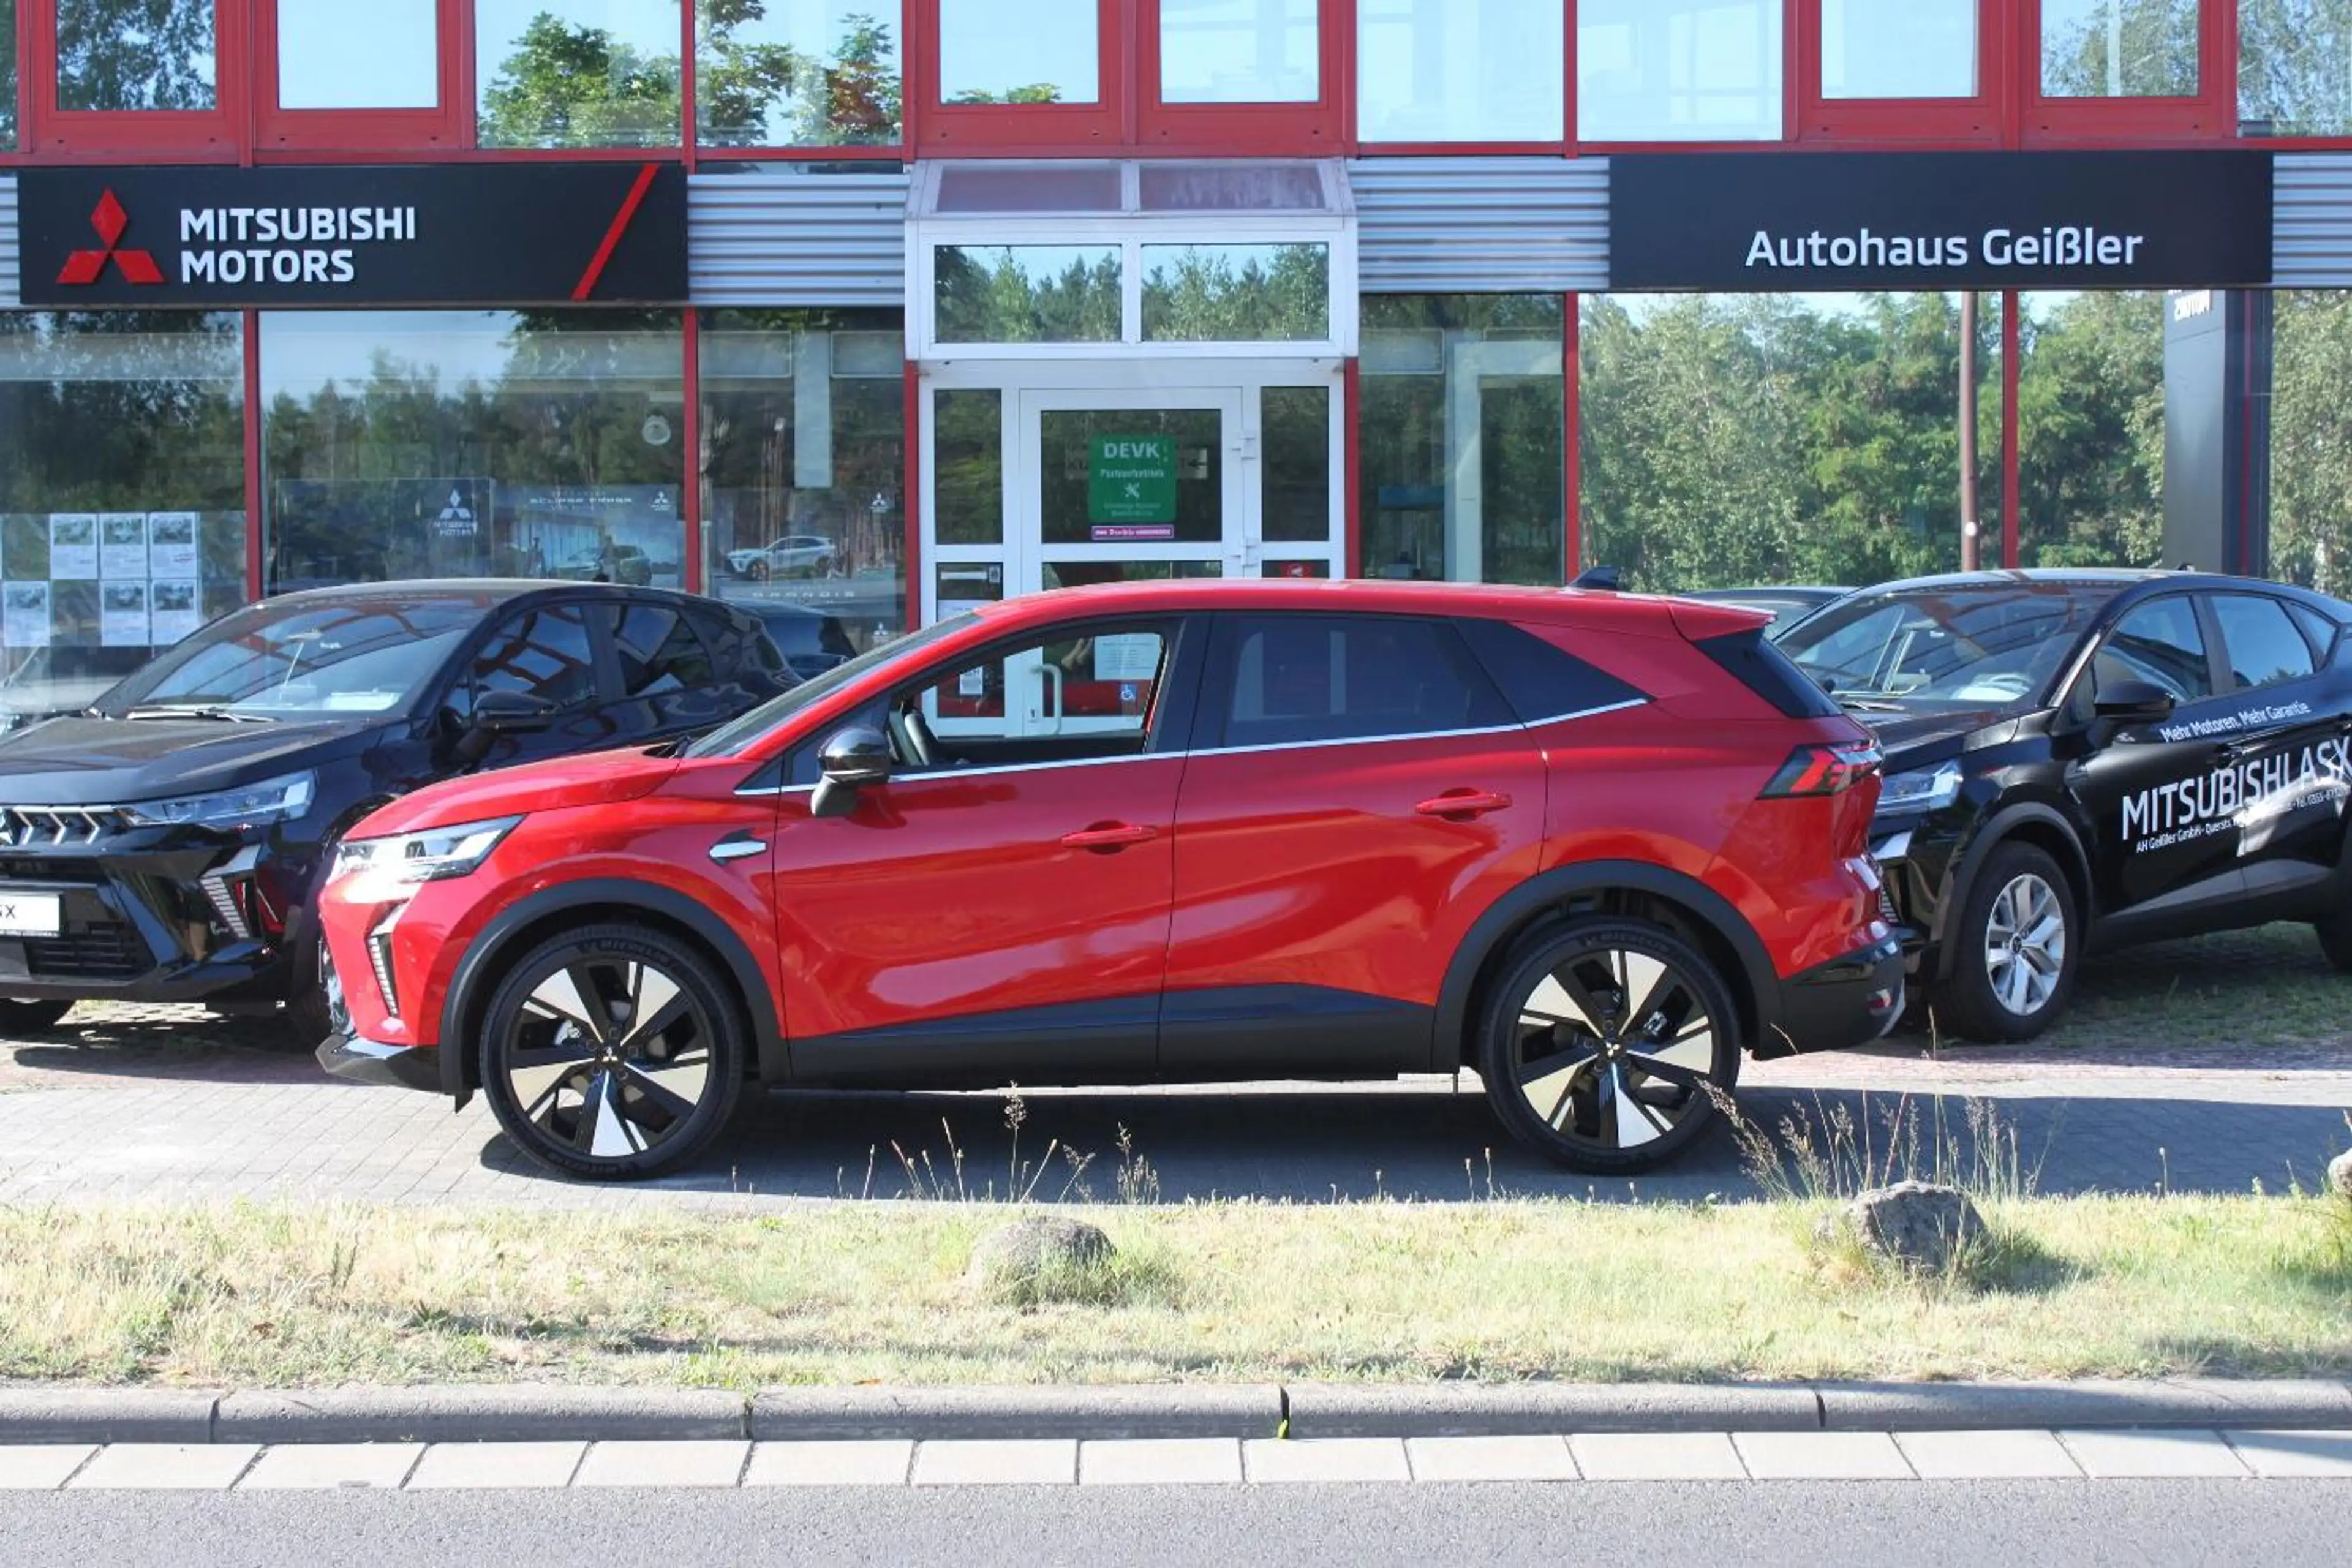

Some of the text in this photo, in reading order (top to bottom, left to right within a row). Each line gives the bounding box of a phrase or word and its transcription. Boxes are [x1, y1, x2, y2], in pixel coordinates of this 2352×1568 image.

[181, 206, 416, 241] MITSUBISHI
[1745, 227, 2143, 267] Autohaus Geißler
[181, 249, 355, 283] MOTORS
[1104, 442, 1160, 459] DEVK
[2160, 725, 2192, 743] Mehr
[2237, 708, 2266, 725] Mehr
[2122, 735, 2352, 840] MITSUBISHI ASX
